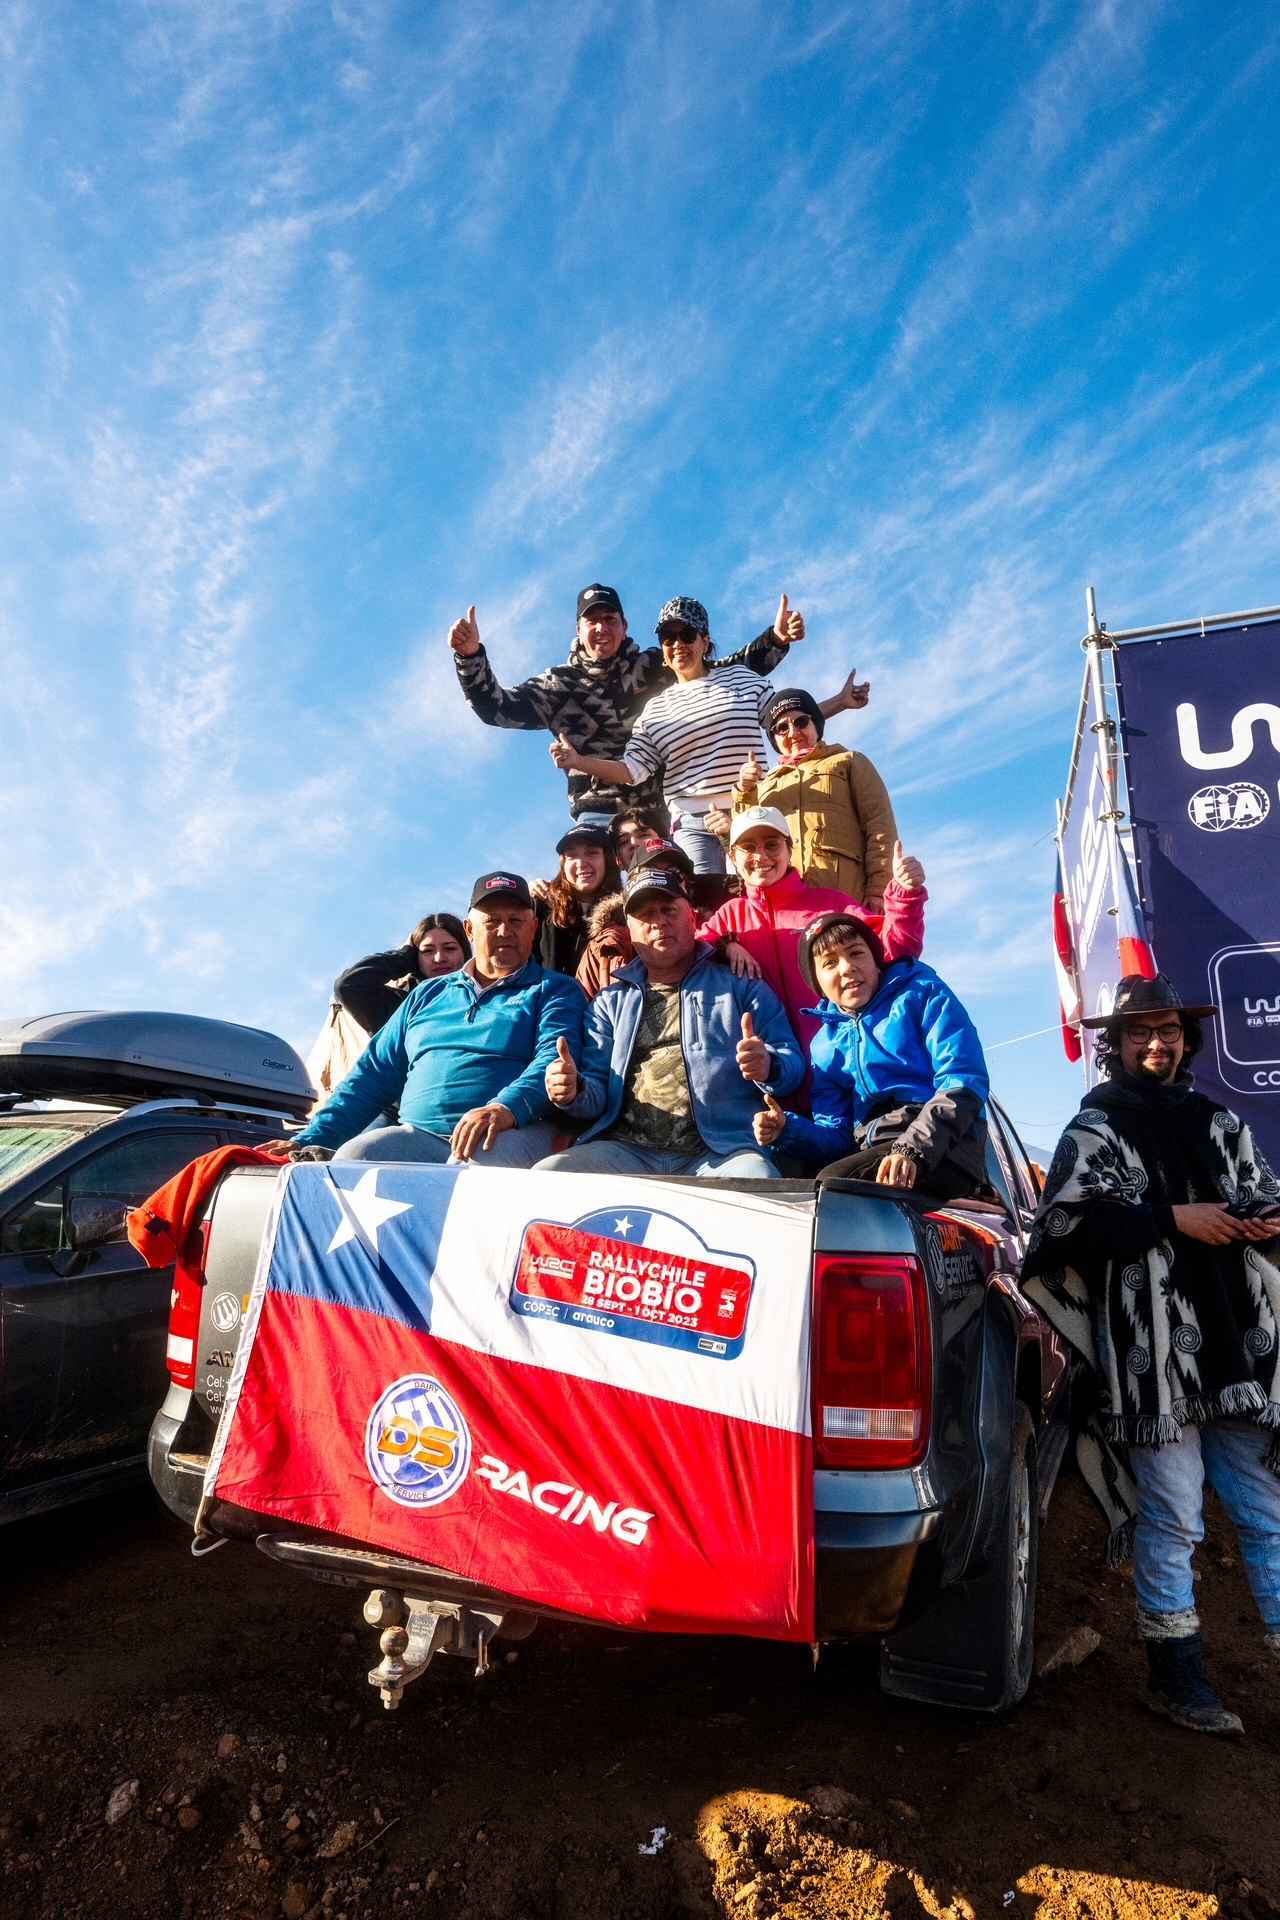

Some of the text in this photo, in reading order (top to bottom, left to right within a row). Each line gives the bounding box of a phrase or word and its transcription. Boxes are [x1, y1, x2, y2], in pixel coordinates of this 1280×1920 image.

[523, 1301, 560, 1317] COPEC
[597, 1299, 626, 1312] SEPT
[667, 1313, 699, 1327] 2023
[572, 1311, 615, 1328] arauco
[414, 1382, 439, 1393] DAIRY
[377, 1415, 459, 1468] DS
[391, 1484, 428, 1499] SERVICE
[474, 1454, 656, 1546] RACING
